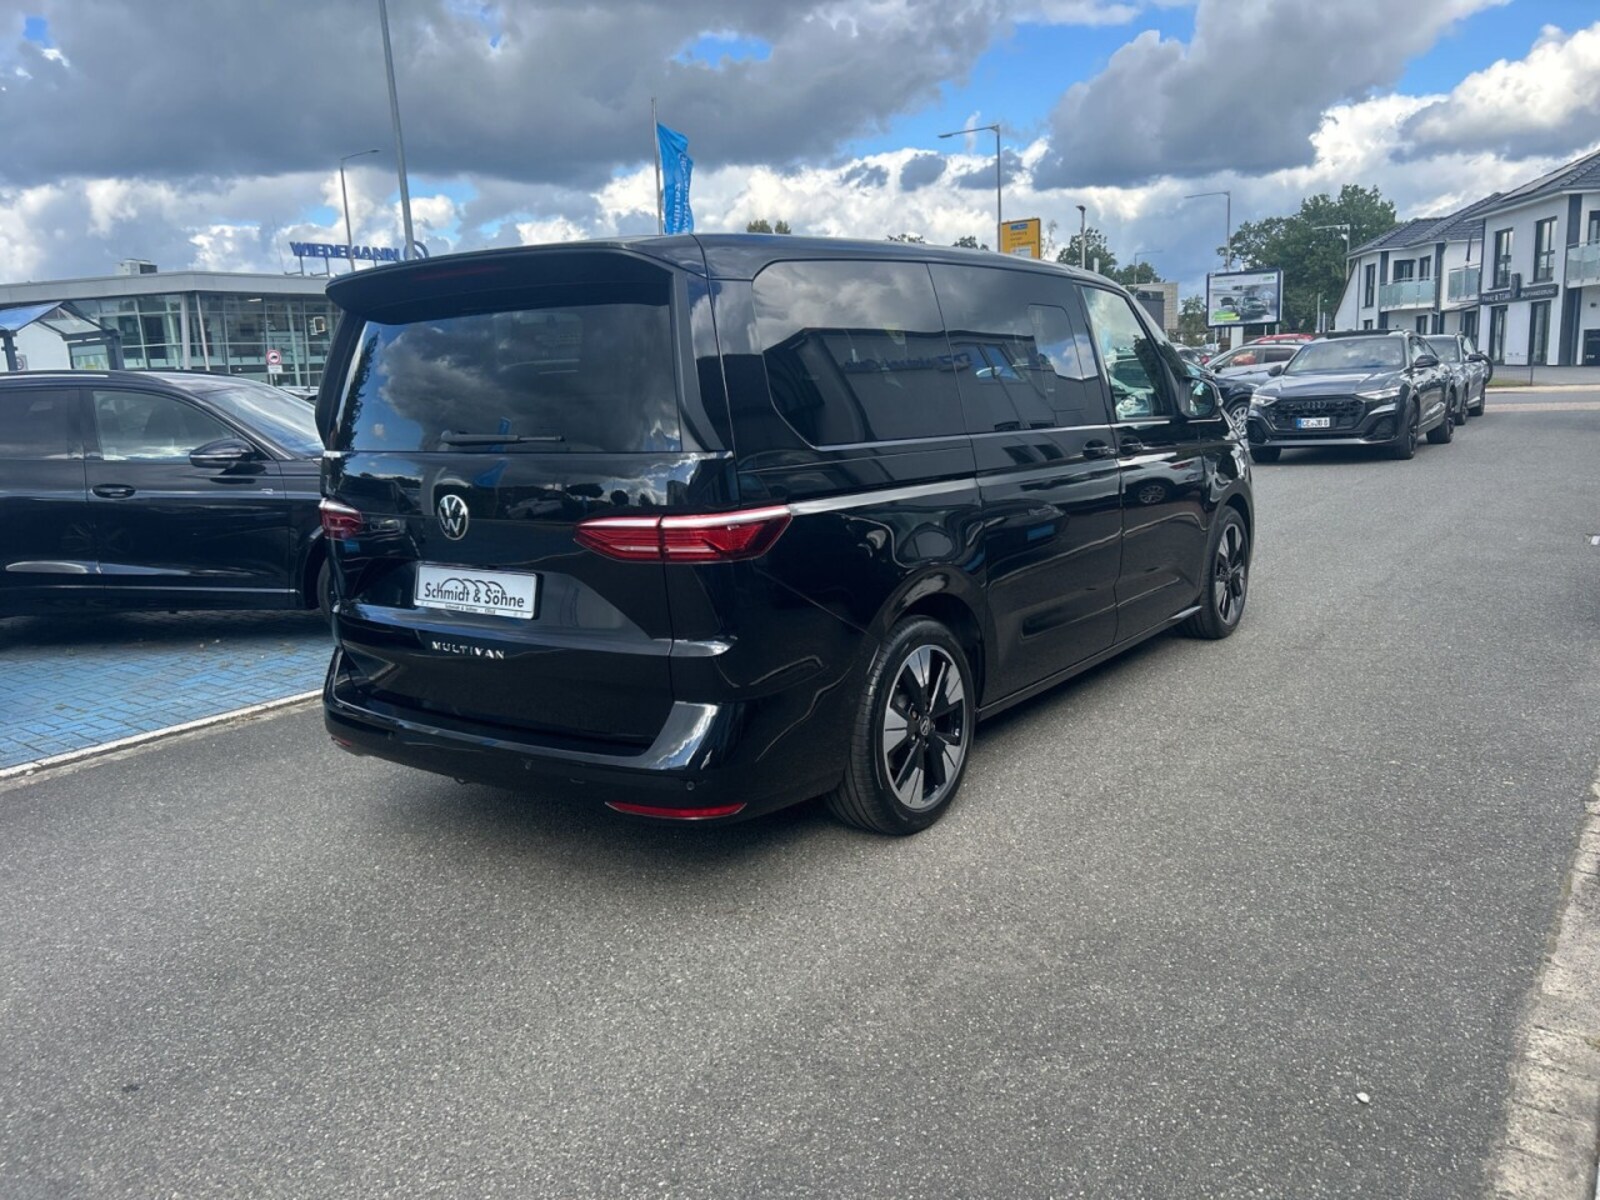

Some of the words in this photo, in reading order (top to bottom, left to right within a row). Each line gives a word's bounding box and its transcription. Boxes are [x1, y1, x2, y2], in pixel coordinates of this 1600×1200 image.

[289, 241, 400, 262] WIEDEMANN
[424, 582, 470, 602] Schmidt
[473, 588, 481, 603] &
[484, 588, 525, 608] Söhne
[431, 640, 505, 660] MULTIVAN
